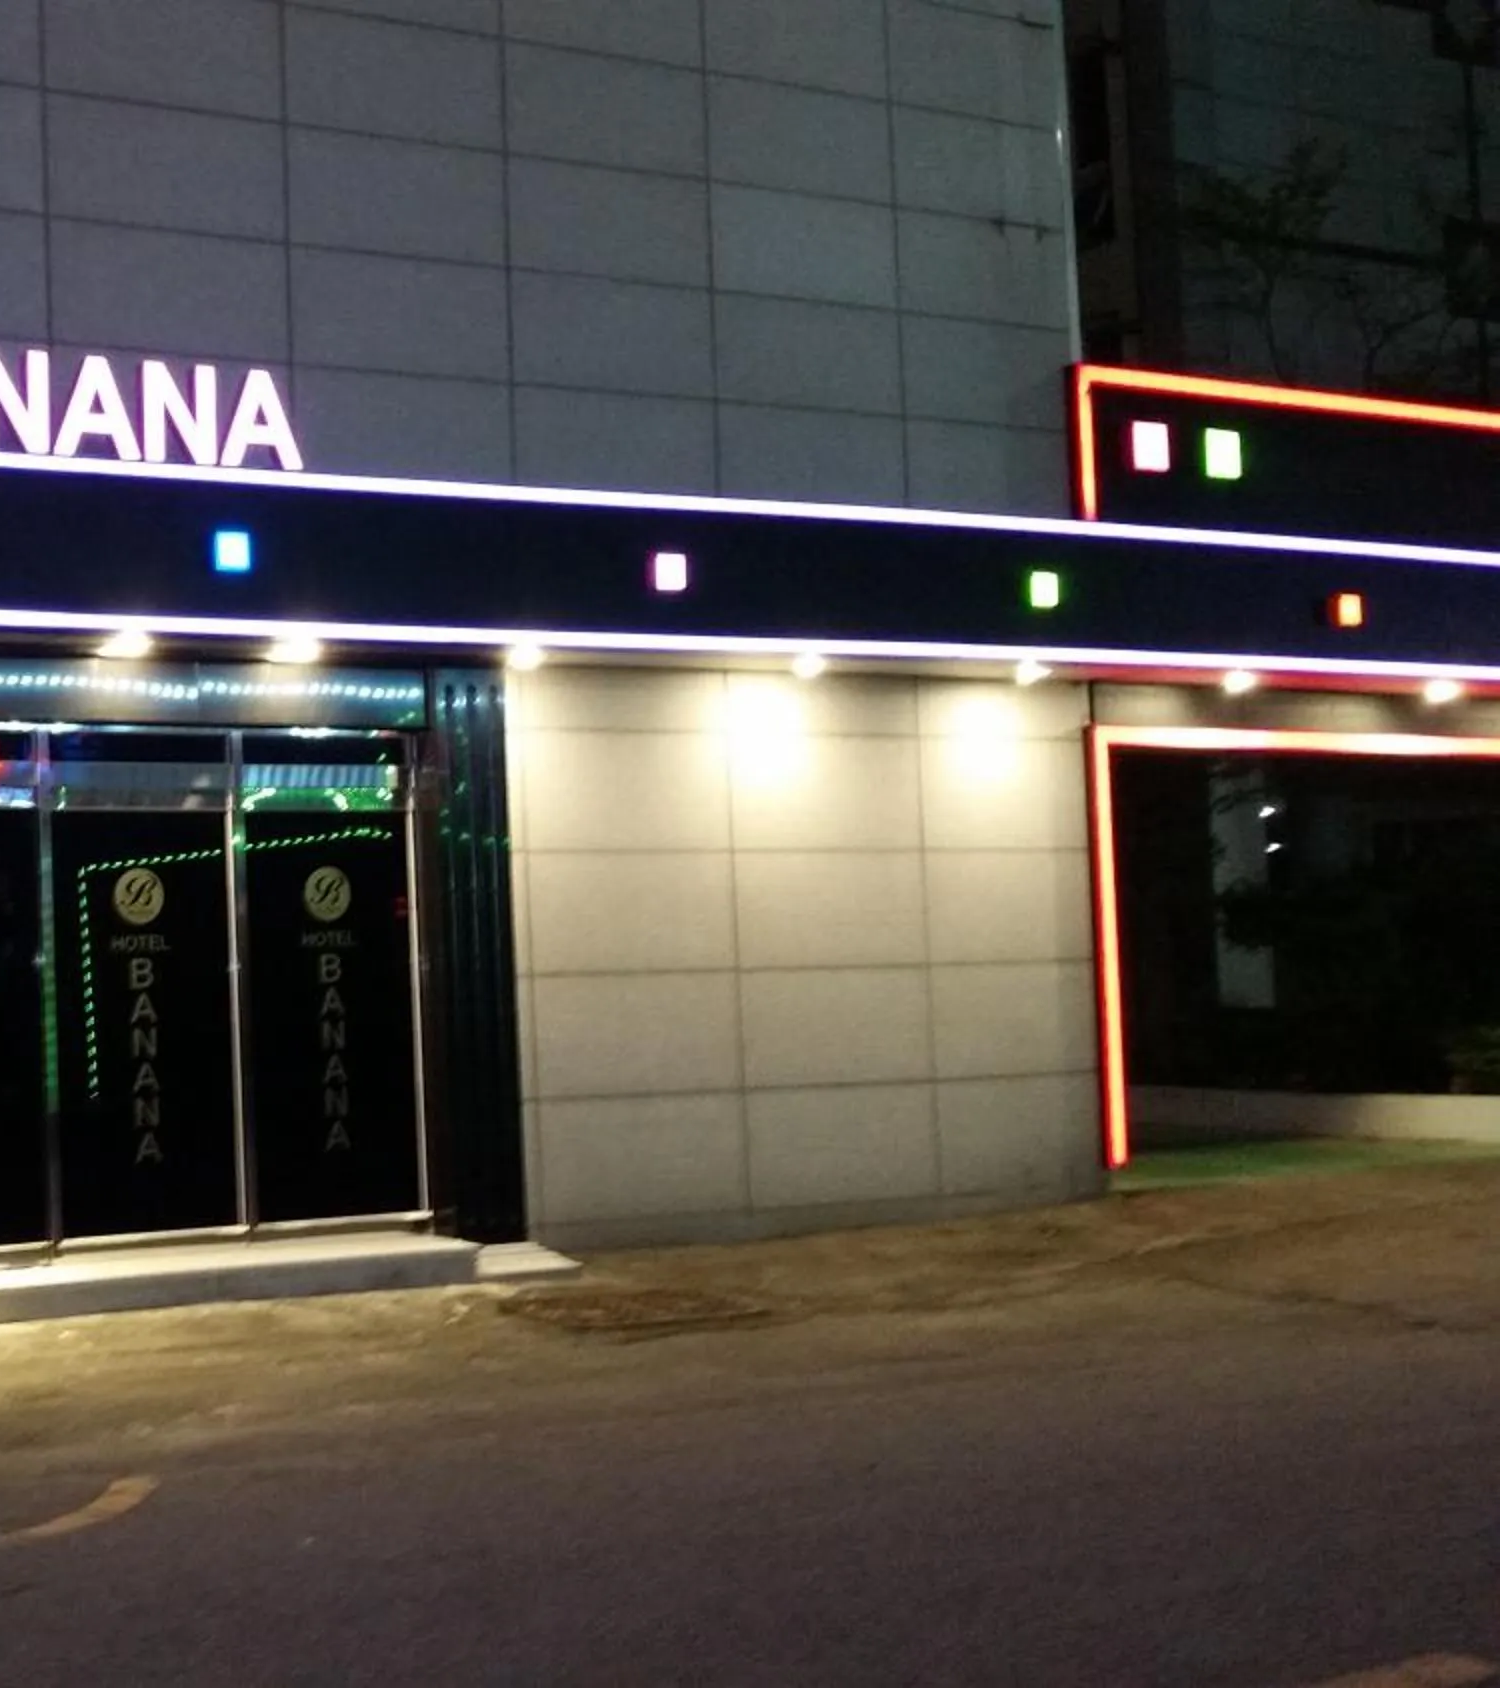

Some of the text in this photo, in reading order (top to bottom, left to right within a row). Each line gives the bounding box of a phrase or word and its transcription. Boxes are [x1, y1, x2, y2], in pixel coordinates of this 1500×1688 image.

[110, 934, 171, 952] HOTEL
[301, 930, 357, 947] HOTEL
[129, 958, 163, 1166] BANANA
[318, 953, 351, 1153] BANANA
